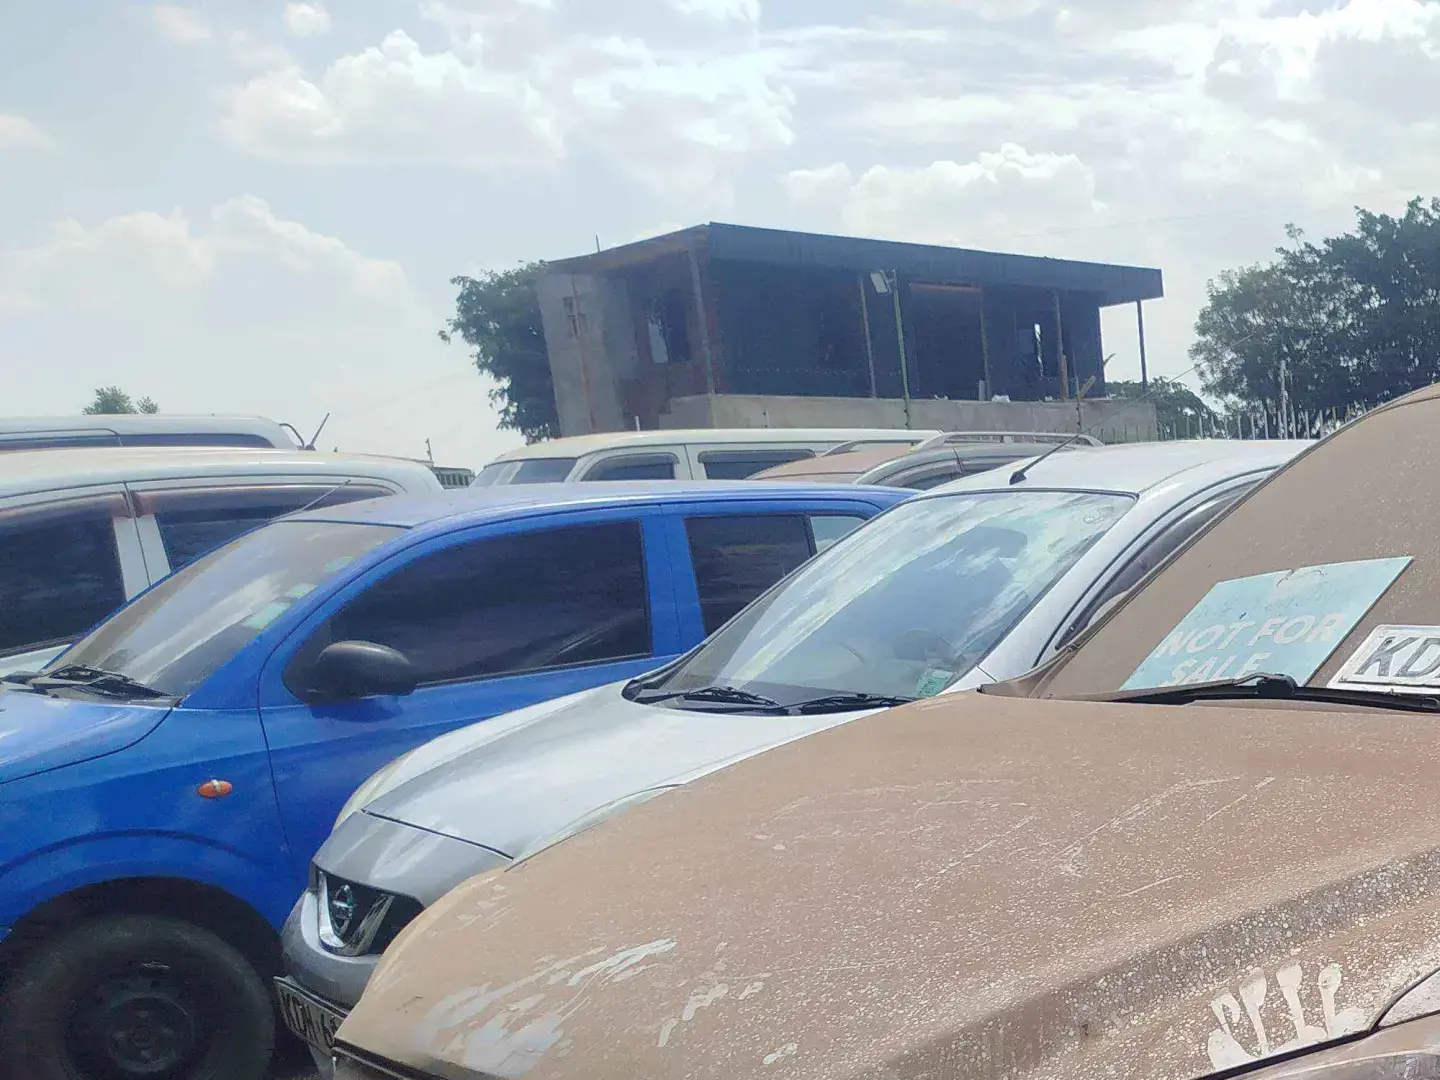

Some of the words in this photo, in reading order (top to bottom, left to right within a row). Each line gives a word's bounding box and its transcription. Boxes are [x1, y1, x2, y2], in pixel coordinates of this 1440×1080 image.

[1153, 620, 1256, 659] NOT
[1246, 612, 1348, 649] FOR
[1159, 652, 1273, 687] SALE
